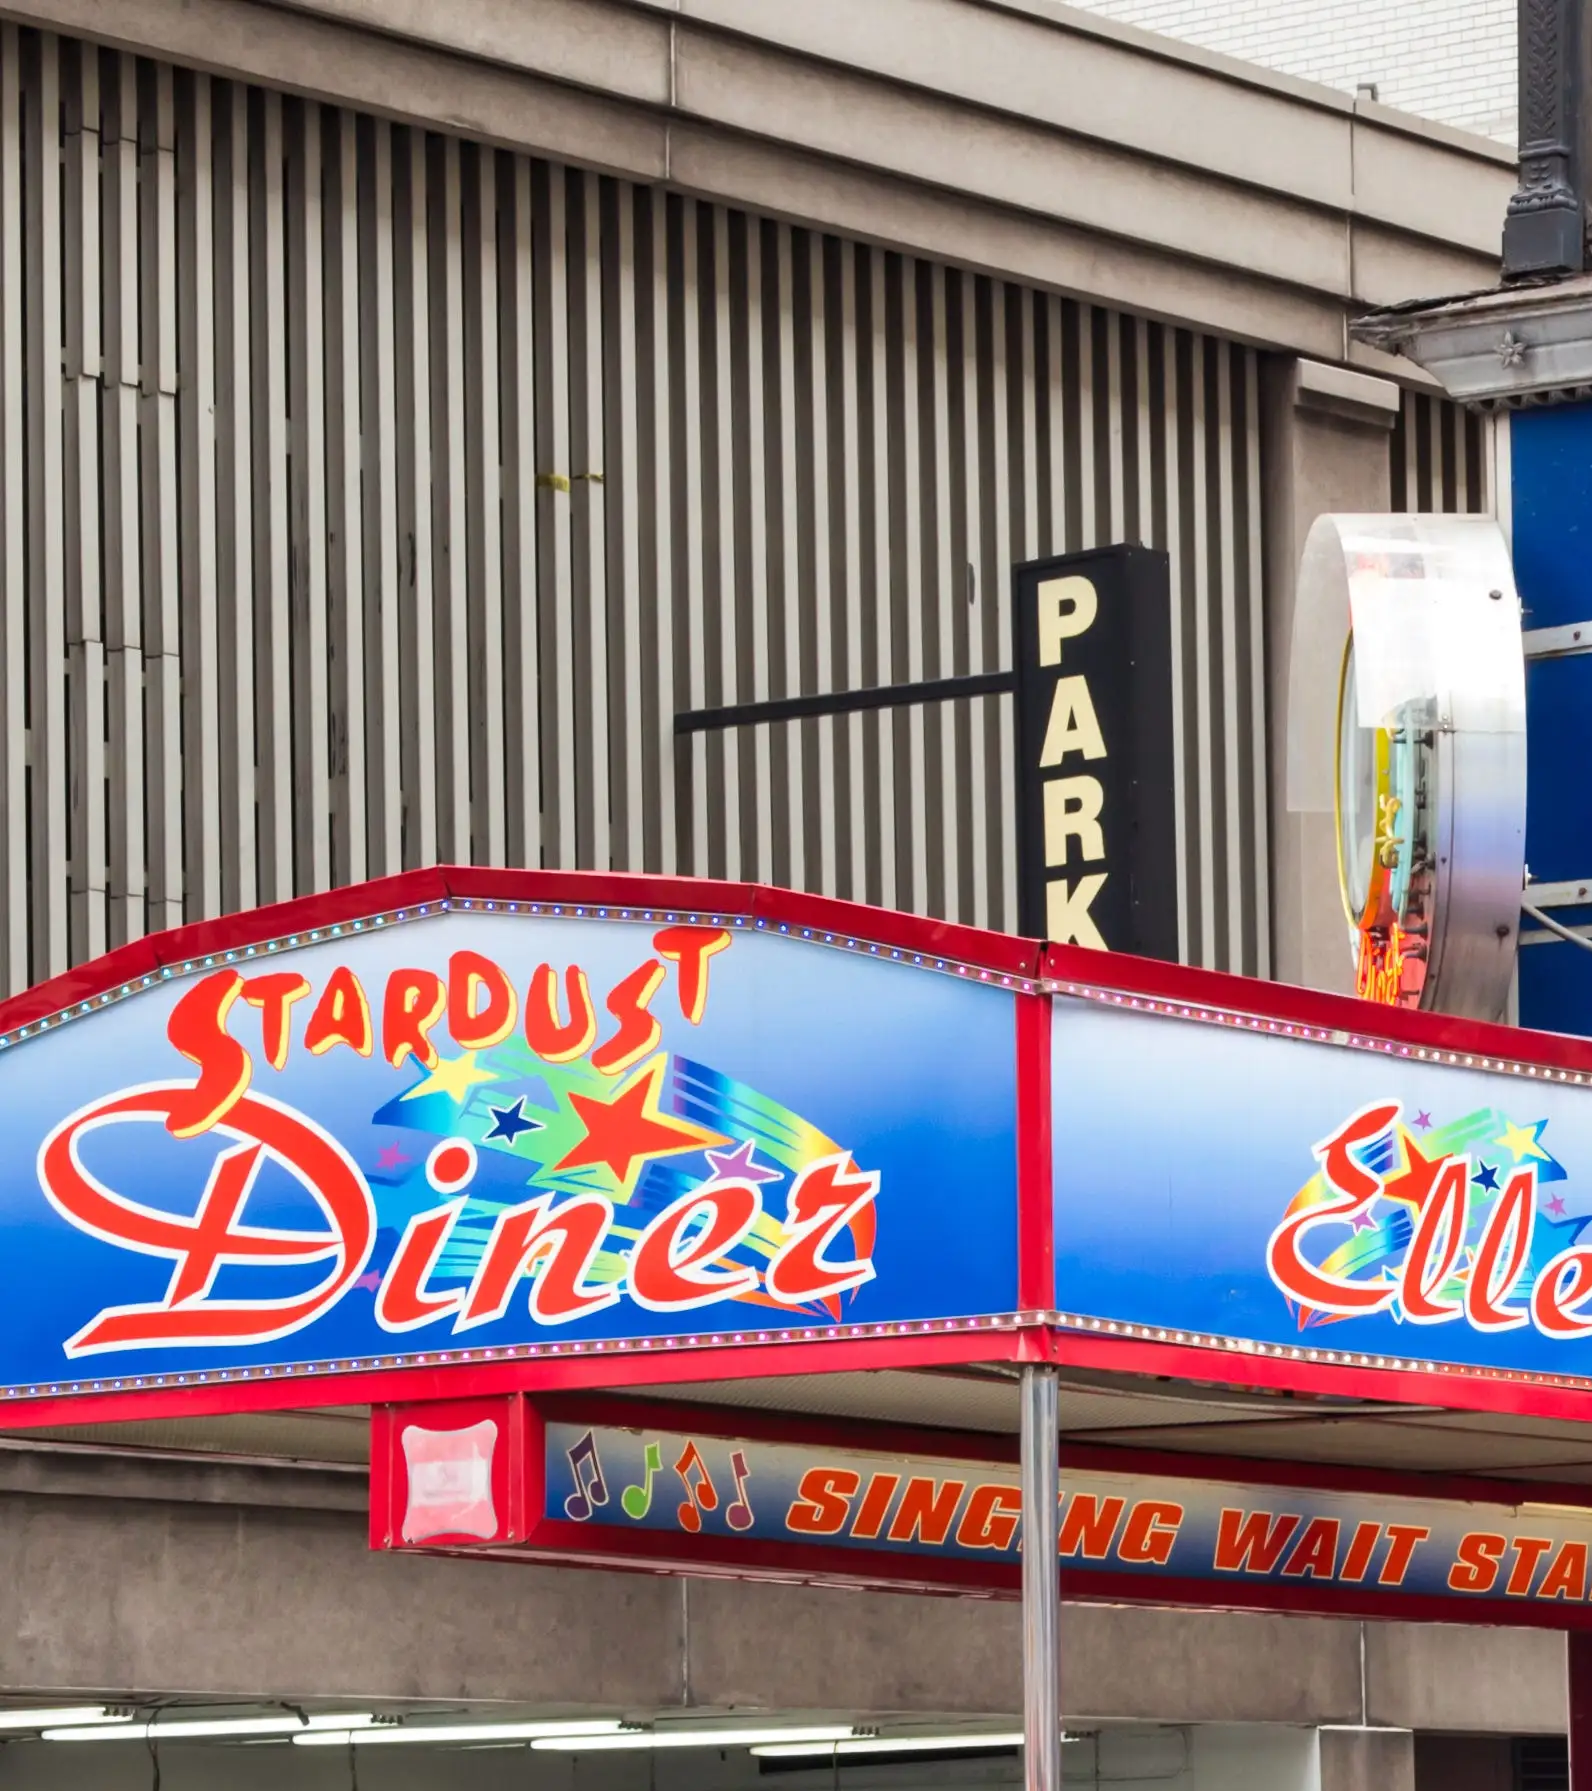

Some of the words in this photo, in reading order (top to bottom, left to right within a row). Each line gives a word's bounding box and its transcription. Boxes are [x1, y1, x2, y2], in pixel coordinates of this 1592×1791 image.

[1037, 574, 1108, 952] PARK
[166, 928, 732, 1139] STARDUST
[36, 1080, 882, 1359] Diner
[786, 1466, 1183, 1566] SINGNG
[1213, 1507, 1428, 1585] WAIT
